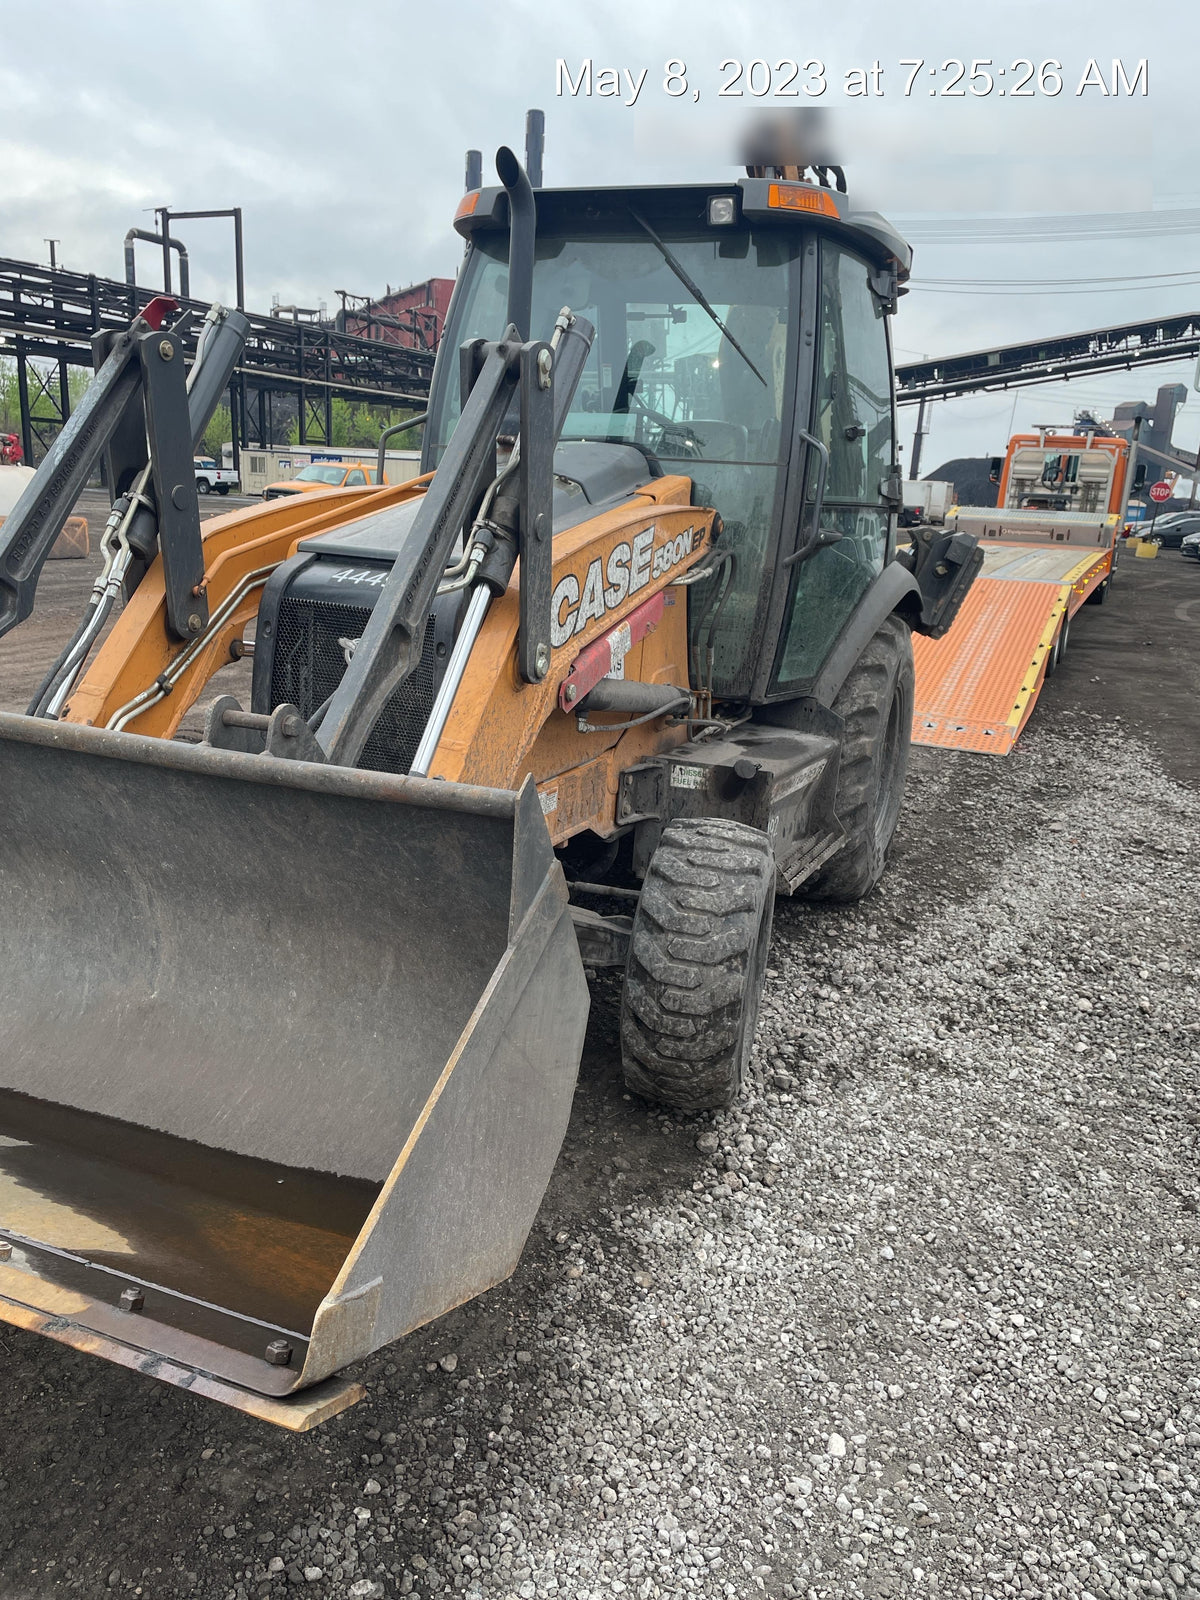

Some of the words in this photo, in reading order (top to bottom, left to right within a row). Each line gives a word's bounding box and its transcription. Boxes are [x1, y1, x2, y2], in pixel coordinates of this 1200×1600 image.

[1151, 487, 1170, 497] STOP
[331, 568, 388, 588] 444
[551, 525, 656, 649] CASE
